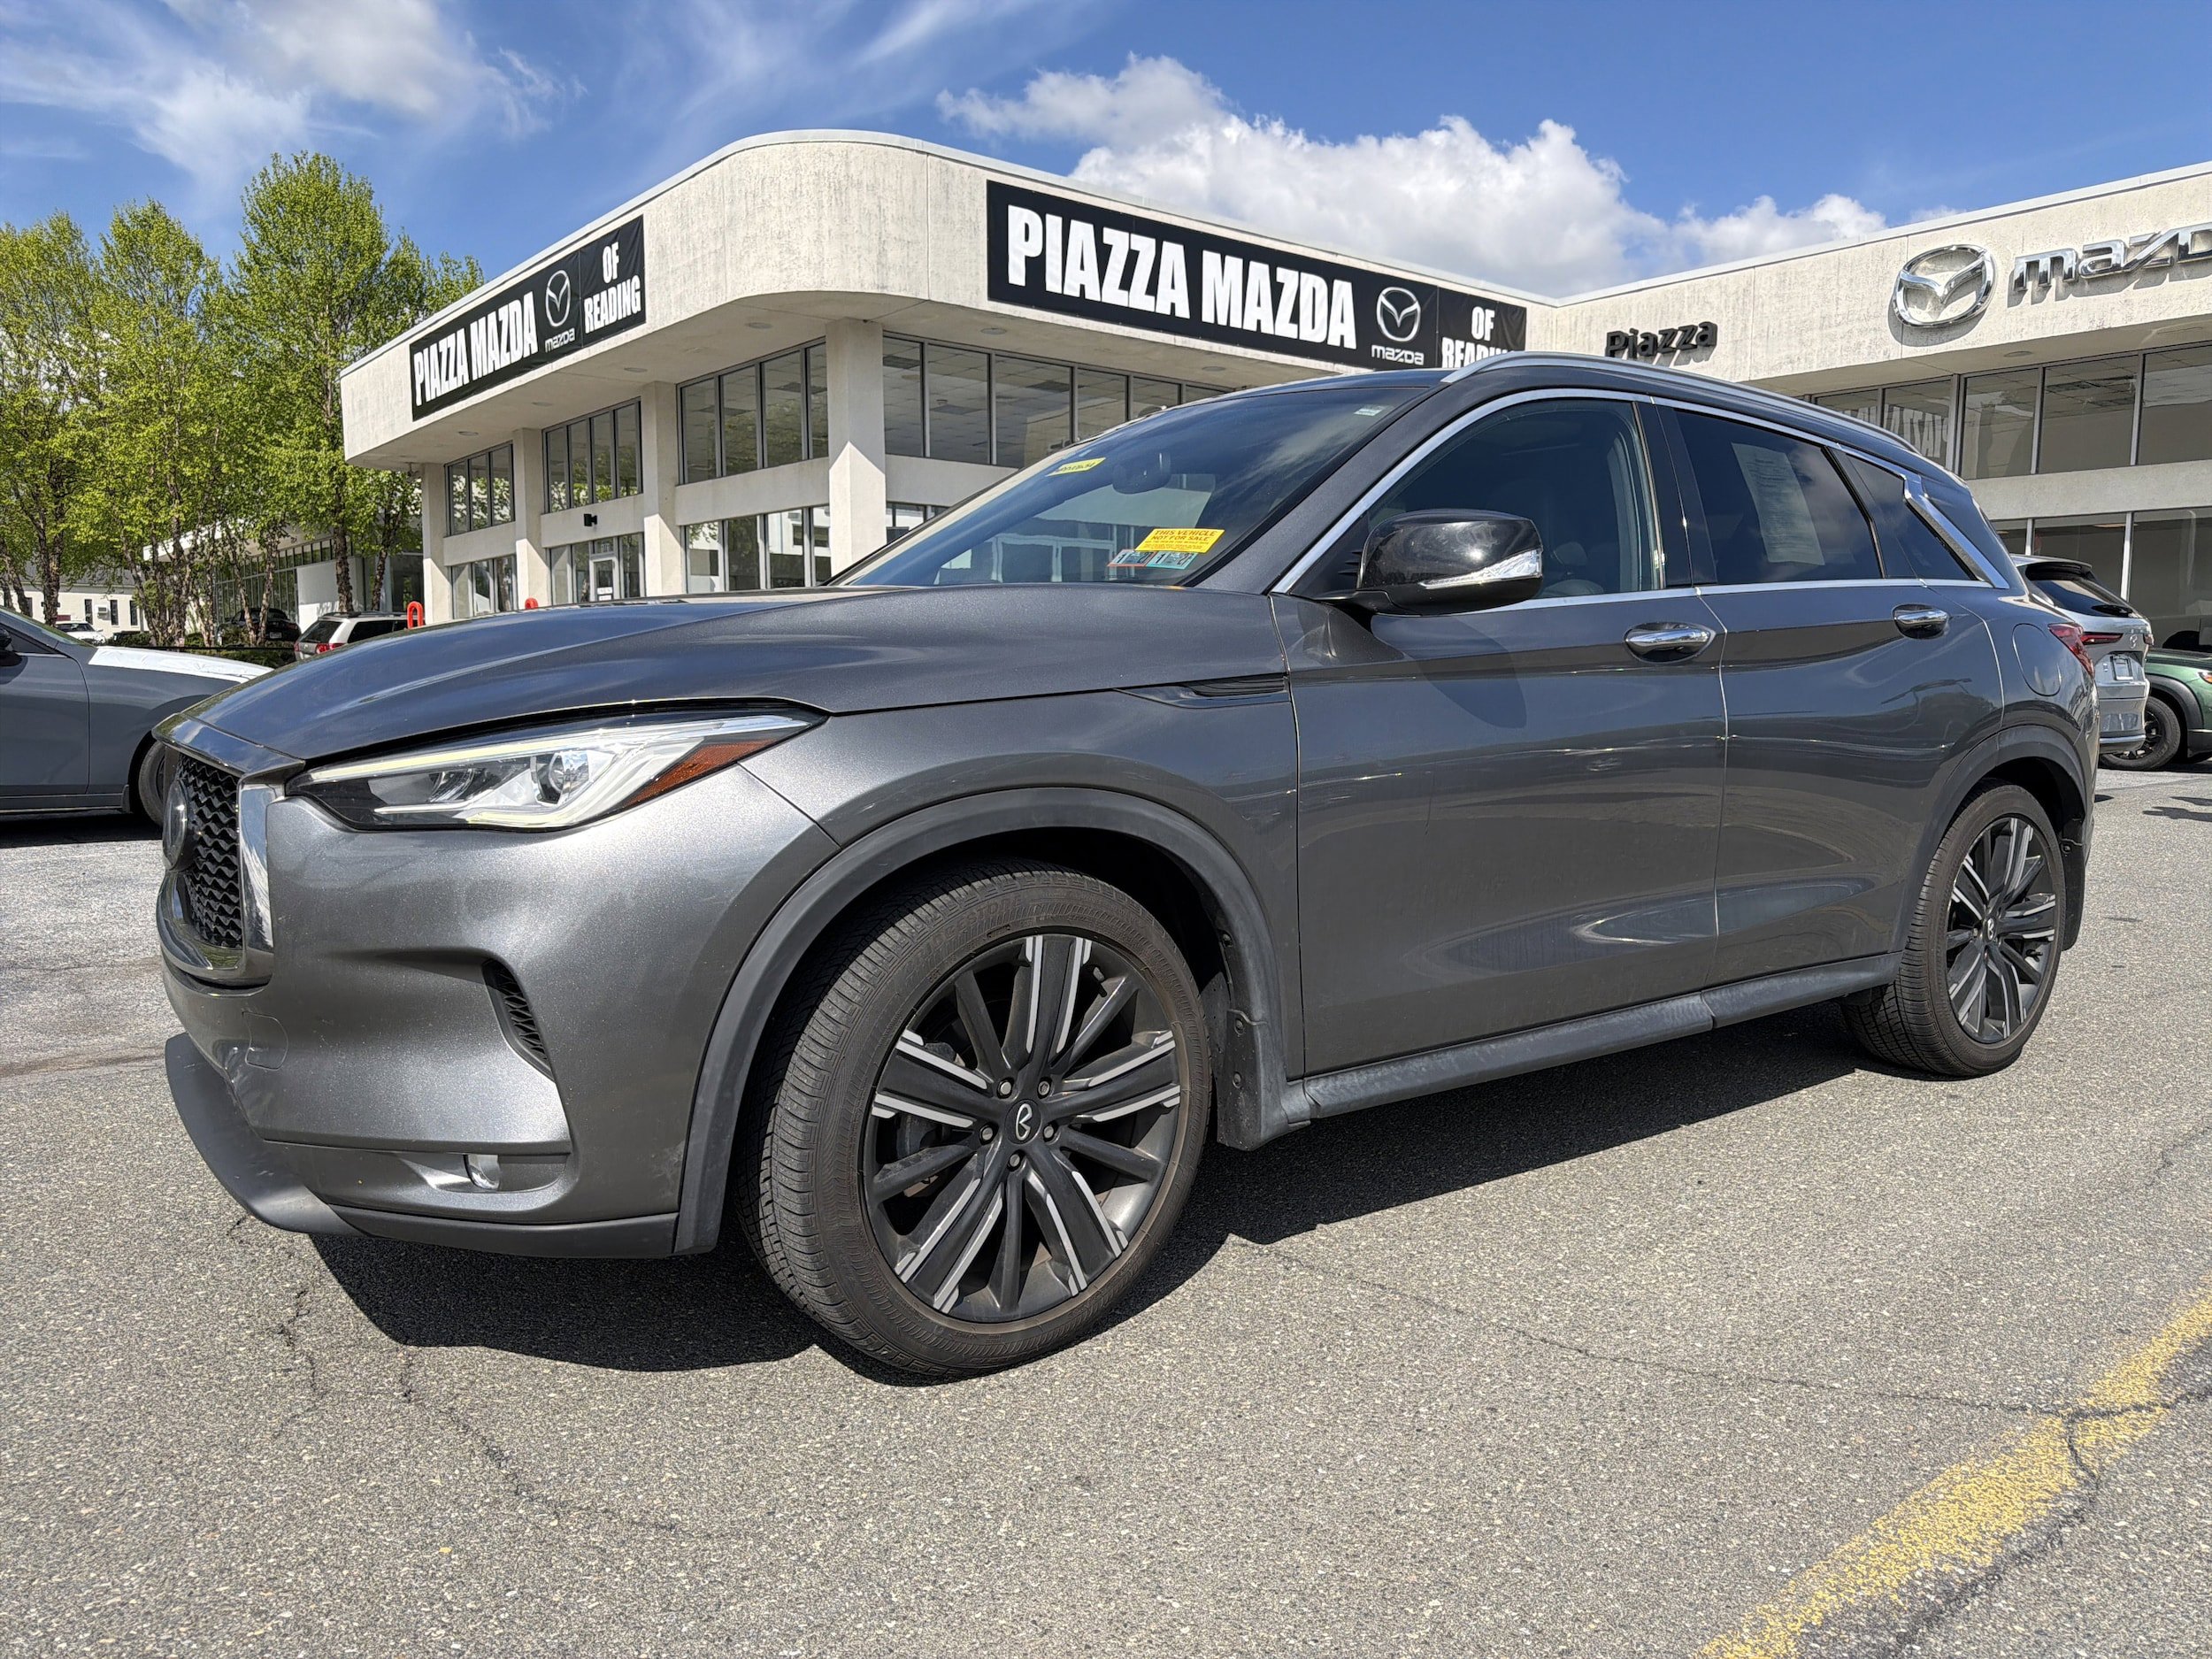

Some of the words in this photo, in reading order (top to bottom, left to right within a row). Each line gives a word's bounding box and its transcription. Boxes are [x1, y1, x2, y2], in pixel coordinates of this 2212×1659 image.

[603, 242, 619, 283] OF
[1008, 204, 1190, 319] PIAZZA
[1202, 250, 1356, 349] MAZDA
[2013, 221, 2212, 291] mazd
[584, 275, 641, 334] READING
[1471, 306, 1495, 342] OF
[413, 327, 469, 407] PIAZZA
[470, 290, 538, 380] MAZDA
[1605, 321, 1717, 359] Piazza
